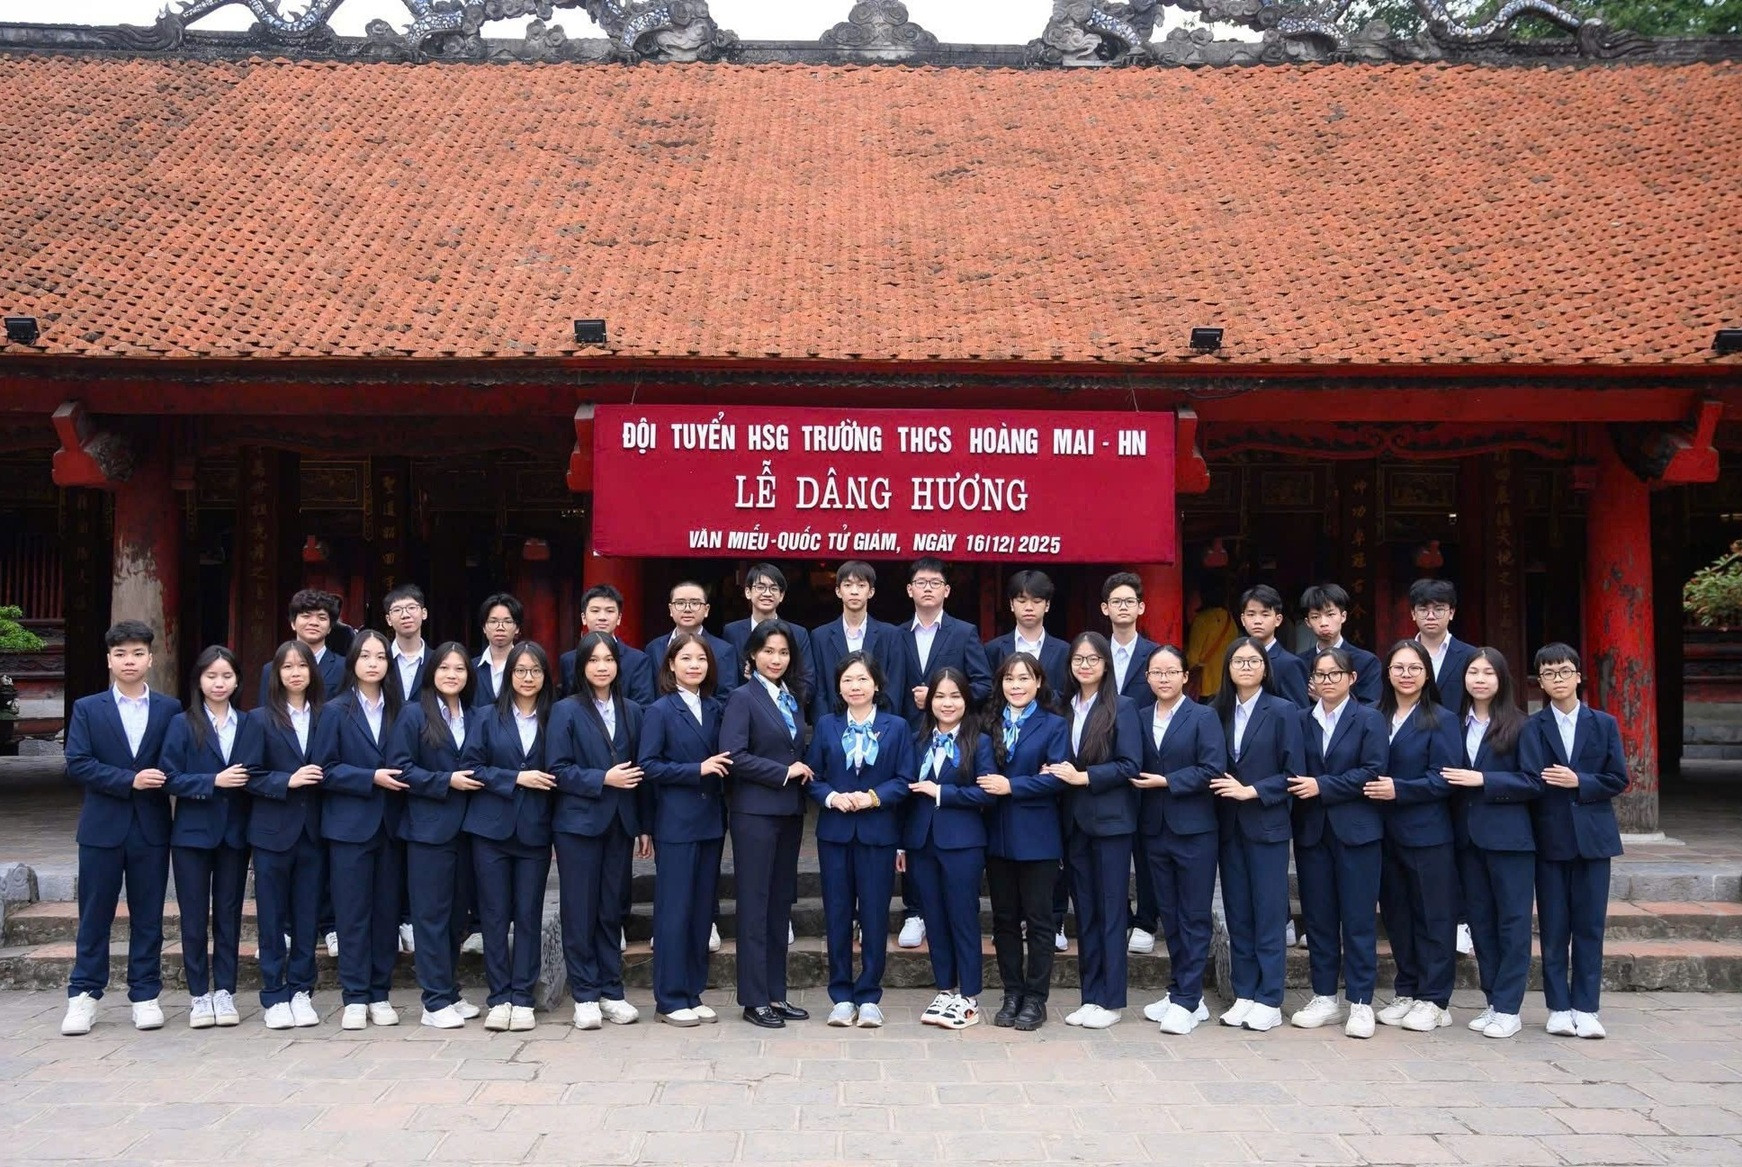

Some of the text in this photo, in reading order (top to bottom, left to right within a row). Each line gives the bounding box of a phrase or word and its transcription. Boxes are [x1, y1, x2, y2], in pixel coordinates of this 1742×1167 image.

[622, 417, 657, 454] ĐỘI
[670, 411, 736, 450] TUYỂN
[748, 424, 789, 451] HSG
[801, 418, 882, 452] TRƯỜNG
[897, 426, 952, 453] THCS
[969, 422, 1039, 454] HOÀNG
[1053, 428, 1095, 455] MAI
[1118, 429, 1147, 456] HN
[734, 459, 1029, 512] LỄ DÂNG HƯƠNG
[689, 527, 723, 549] VĂN
[827, 523, 852, 552] TỬ
[853, 529, 901, 554] GIÁM,
[912, 528, 958, 552] NGÀY
